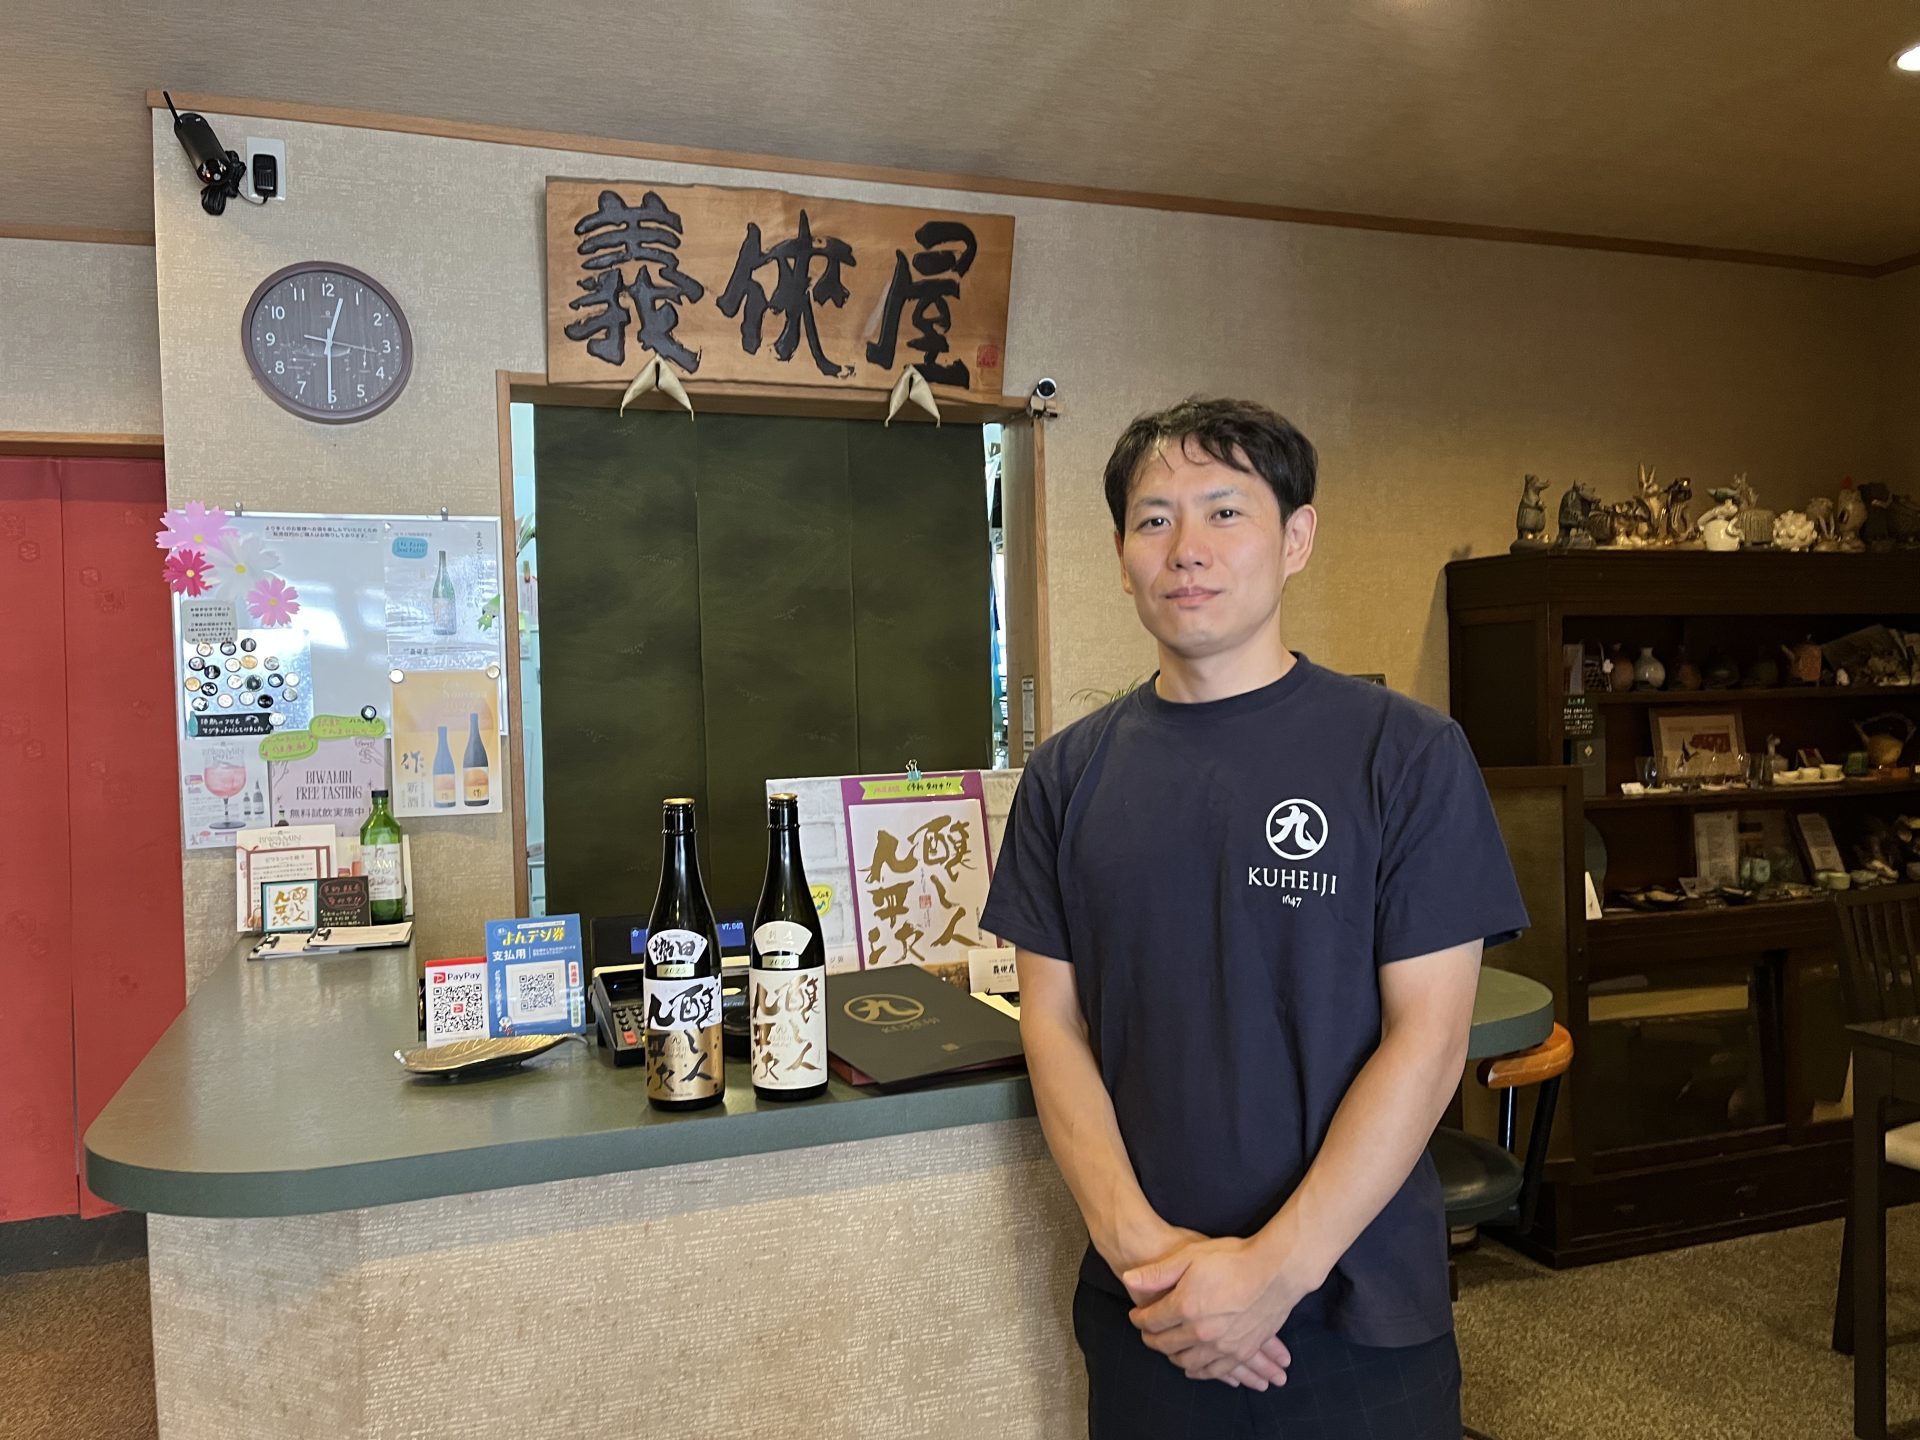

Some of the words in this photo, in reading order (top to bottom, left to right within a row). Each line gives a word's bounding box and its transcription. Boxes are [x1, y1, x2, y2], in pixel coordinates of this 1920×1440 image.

[294, 287, 305, 301] 11
[322, 283, 335, 297] 12
[271, 306, 286, 320] 10
[373, 312, 383, 327] 2
[265, 332, 276, 346] 9
[382, 339, 391, 353] 3
[275, 361, 285, 374] 8
[375, 366, 385, 379] 4
[297, 380, 307, 395] 7
[356, 384, 366, 397] 5
[306, 770, 352, 785] BIWAMIN
[296, 786, 320, 801] FREE
[321, 785, 362, 800] TASTING
[1248, 867, 1337, 897] KUHEIJI
[492, 948, 527, 962] 支払用
[447, 971, 481, 981] PayPay
[664, 967, 687, 975] 2025
